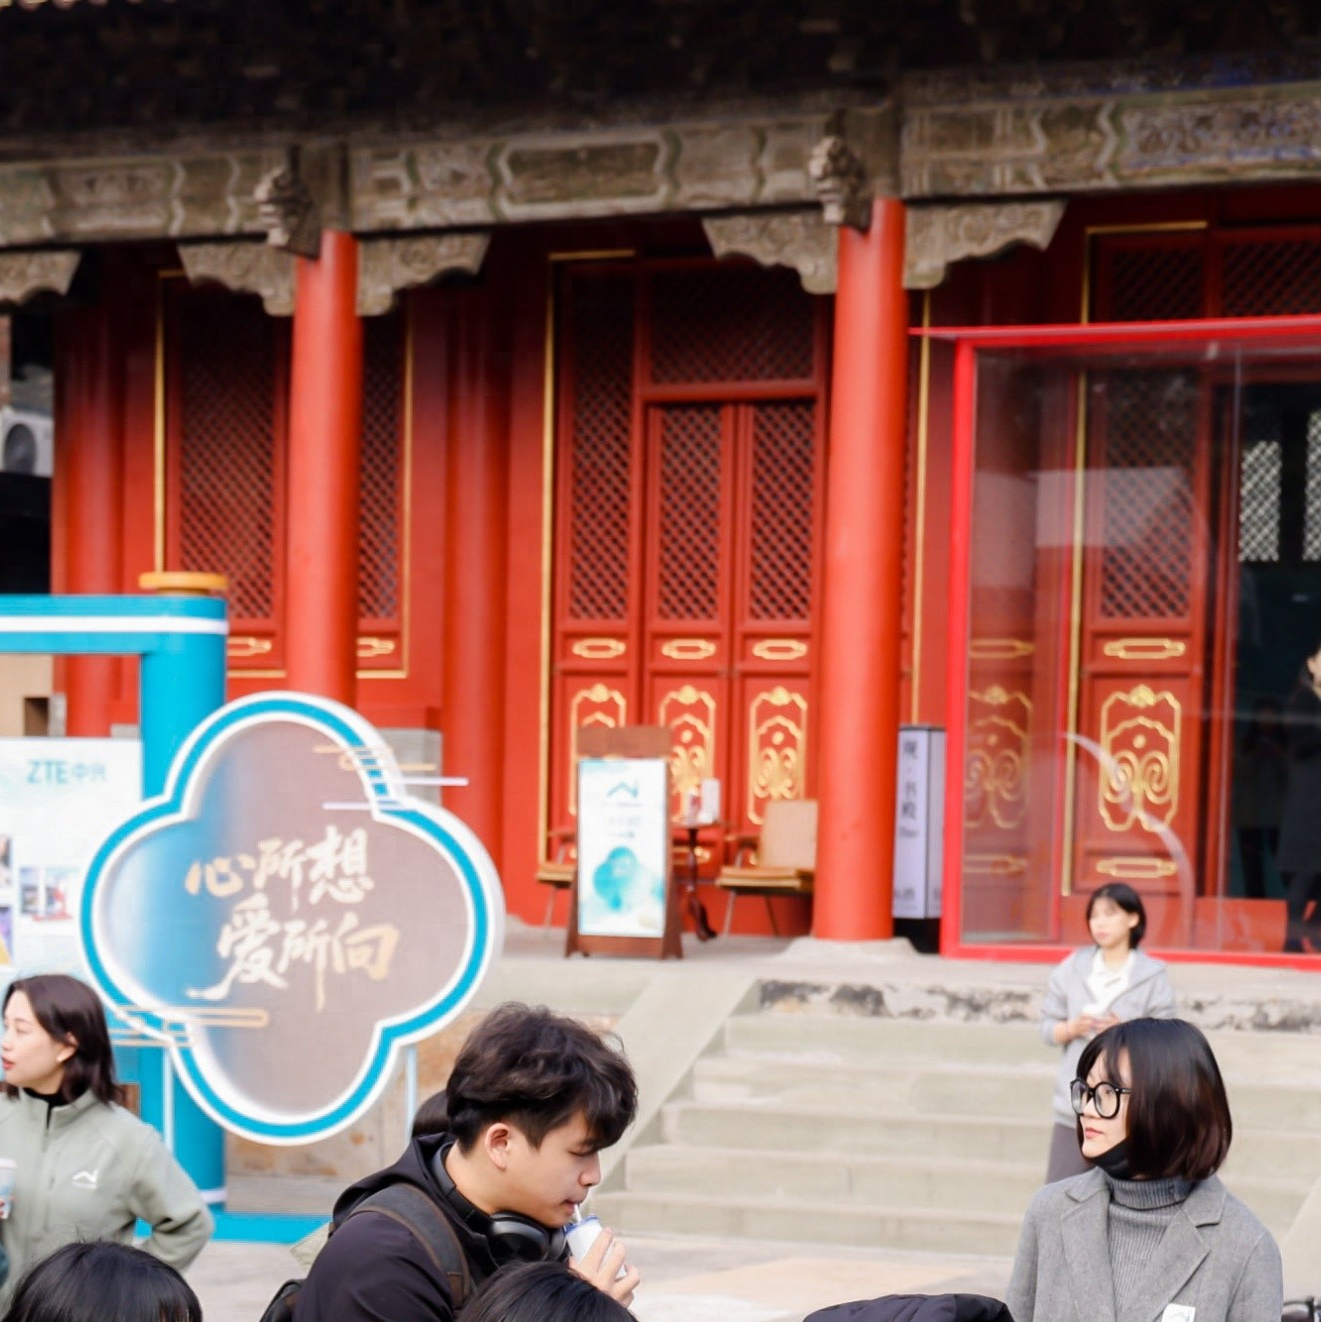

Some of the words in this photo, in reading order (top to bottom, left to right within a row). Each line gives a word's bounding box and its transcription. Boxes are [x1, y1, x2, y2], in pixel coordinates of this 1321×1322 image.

[185, 825, 376, 912] 心所想
[186, 893, 401, 1012] 爱所向
